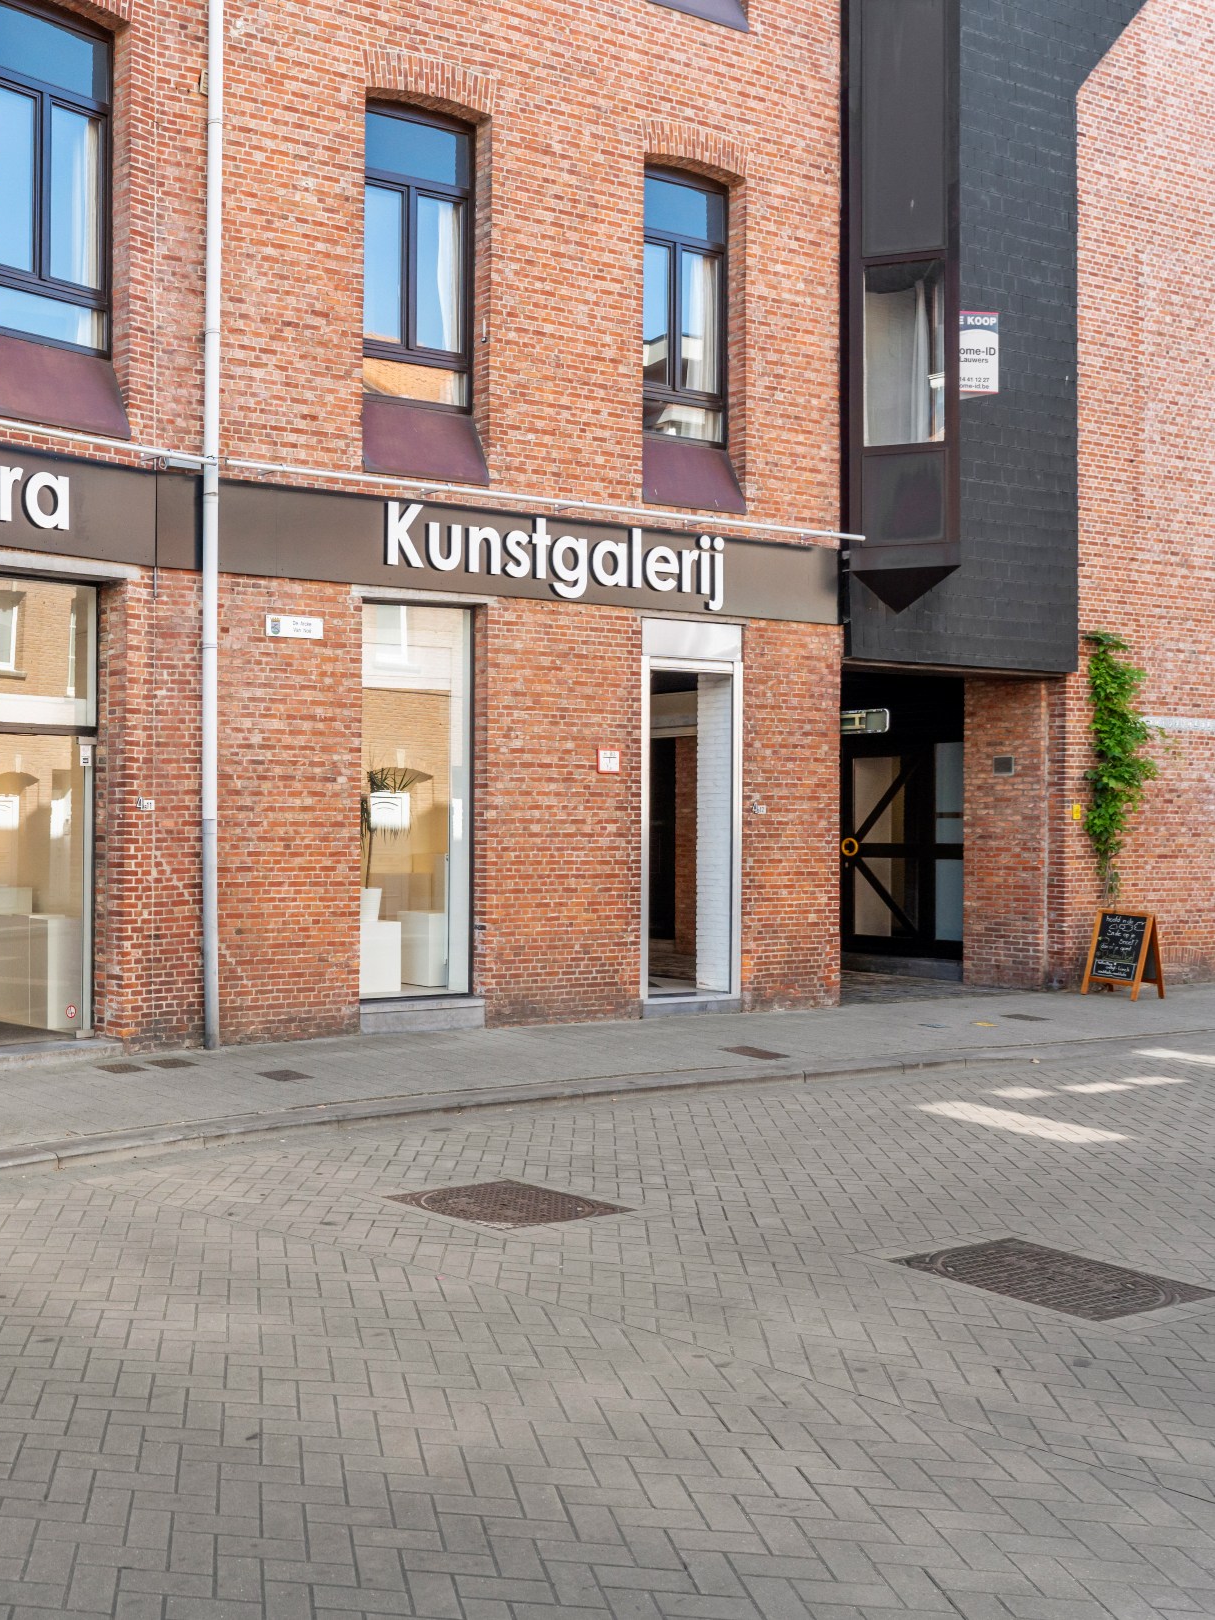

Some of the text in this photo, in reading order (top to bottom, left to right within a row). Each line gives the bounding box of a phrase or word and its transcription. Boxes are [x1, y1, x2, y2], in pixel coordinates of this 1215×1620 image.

[967, 316, 996, 326] KOOP
[960, 347, 996, 356] ome-ID
[387, 501, 725, 611] Kunstgalerij
